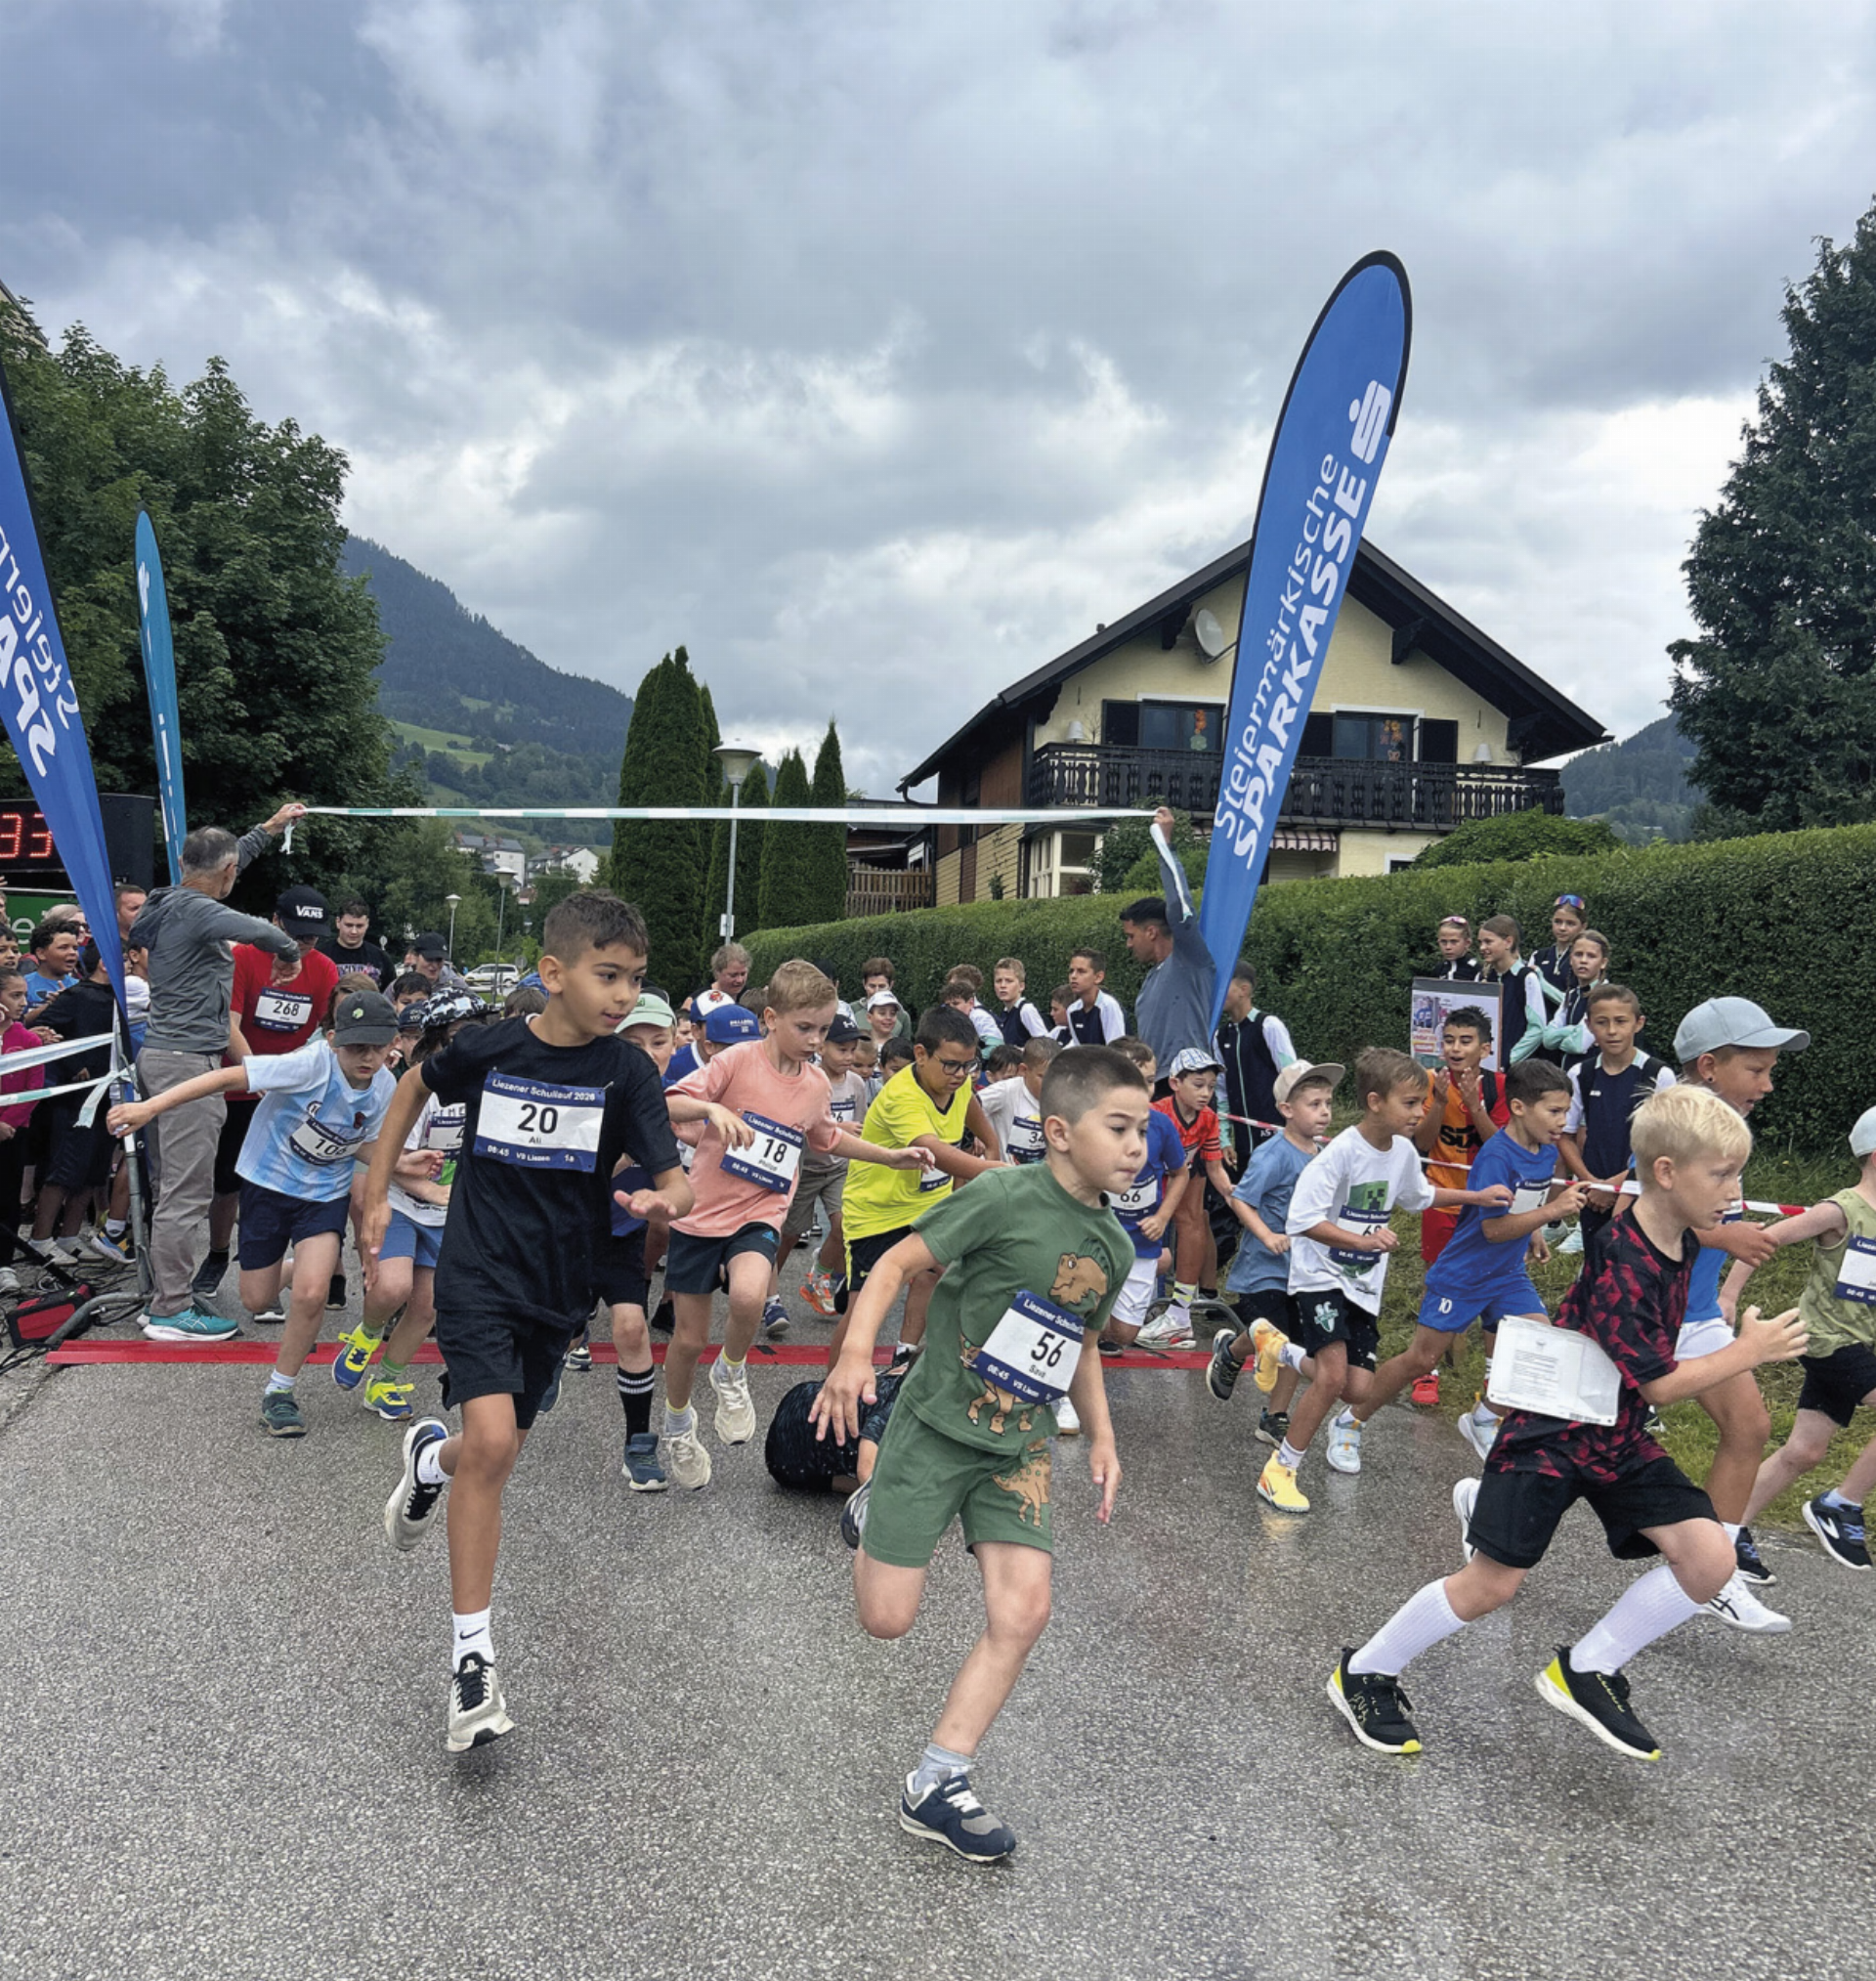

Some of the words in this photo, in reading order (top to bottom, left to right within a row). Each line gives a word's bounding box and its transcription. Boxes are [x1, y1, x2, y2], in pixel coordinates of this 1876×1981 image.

[1214, 453, 1339, 839] Steiermärkische
[1234, 465, 1367, 870] SPARKASSE
[295, 905, 323, 919] VANS
[273, 1000, 300, 1015] 268
[518, 1103, 558, 1134] 20
[763, 1139, 788, 1163] 18
[1438, 1297, 1453, 1314] 10
[1031, 1331, 1066, 1367] 56
